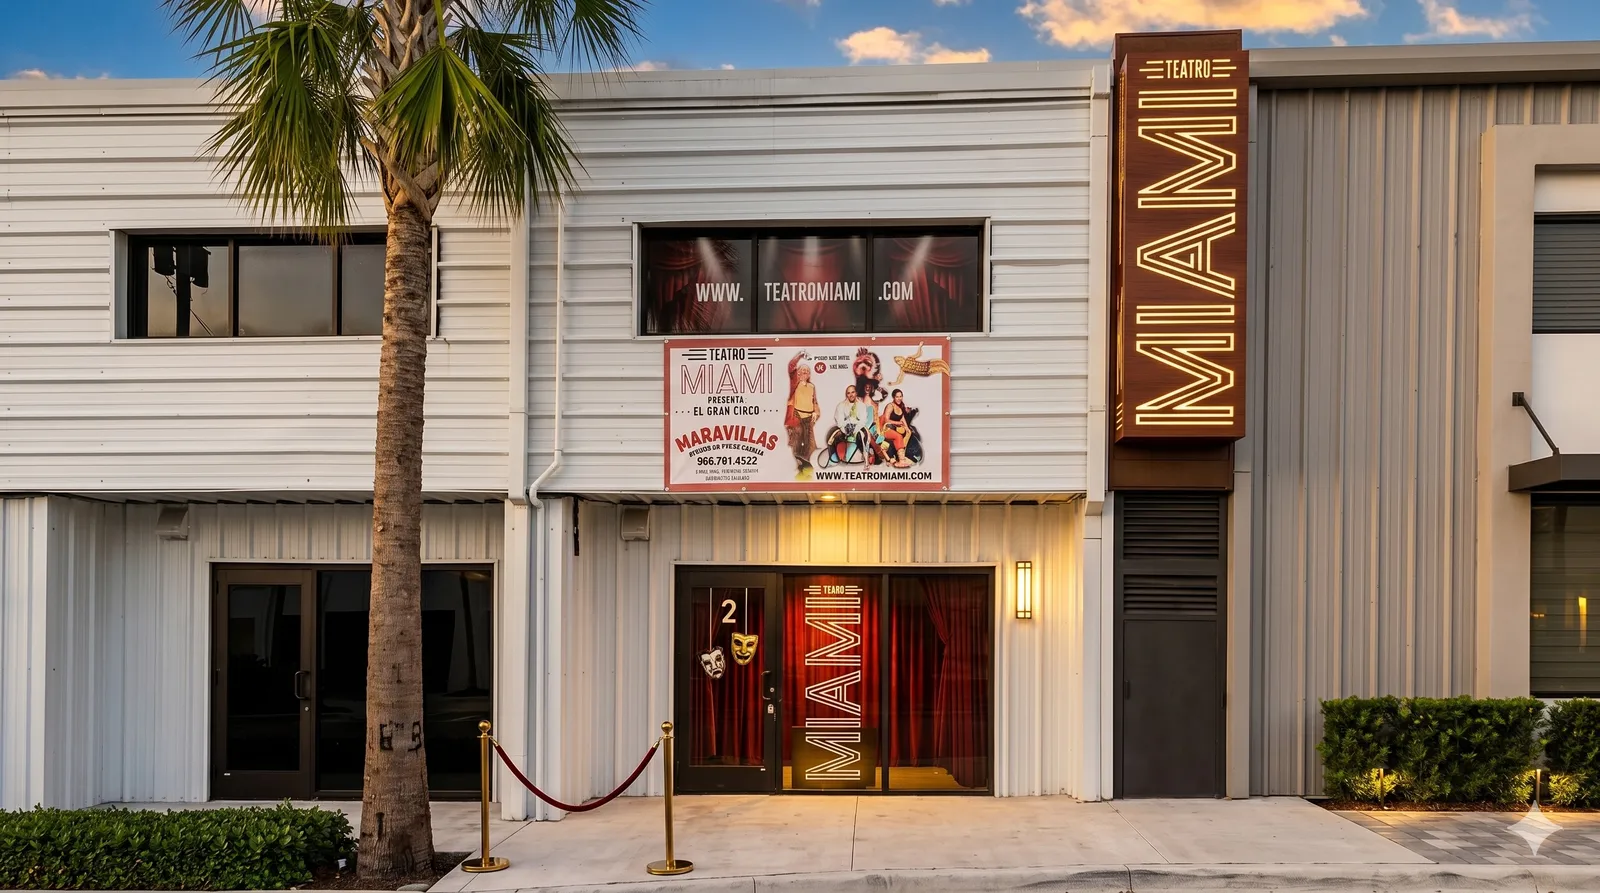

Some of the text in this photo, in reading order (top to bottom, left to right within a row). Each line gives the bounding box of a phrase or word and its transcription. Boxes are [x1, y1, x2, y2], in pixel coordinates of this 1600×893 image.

[1165, 59, 1211, 79] TEATRO
[1135, 88, 1237, 425] MIAMI
[695, 280, 914, 302] WWW. TEATROMIAMI .COM
[709, 348, 746, 361] TEATRO
[680, 363, 773, 394] MIAMI
[693, 405, 760, 416] EL GRAN CIRCO
[674, 424, 779, 453] MARAVILLAS
[697, 456, 758, 466] 966.701.4522
[816, 471, 932, 480] WWW.TEATROMIAMI.COM
[823, 585, 845, 595] TEARO
[721, 599, 737, 624] 2
[805, 597, 861, 780] MIAMI
